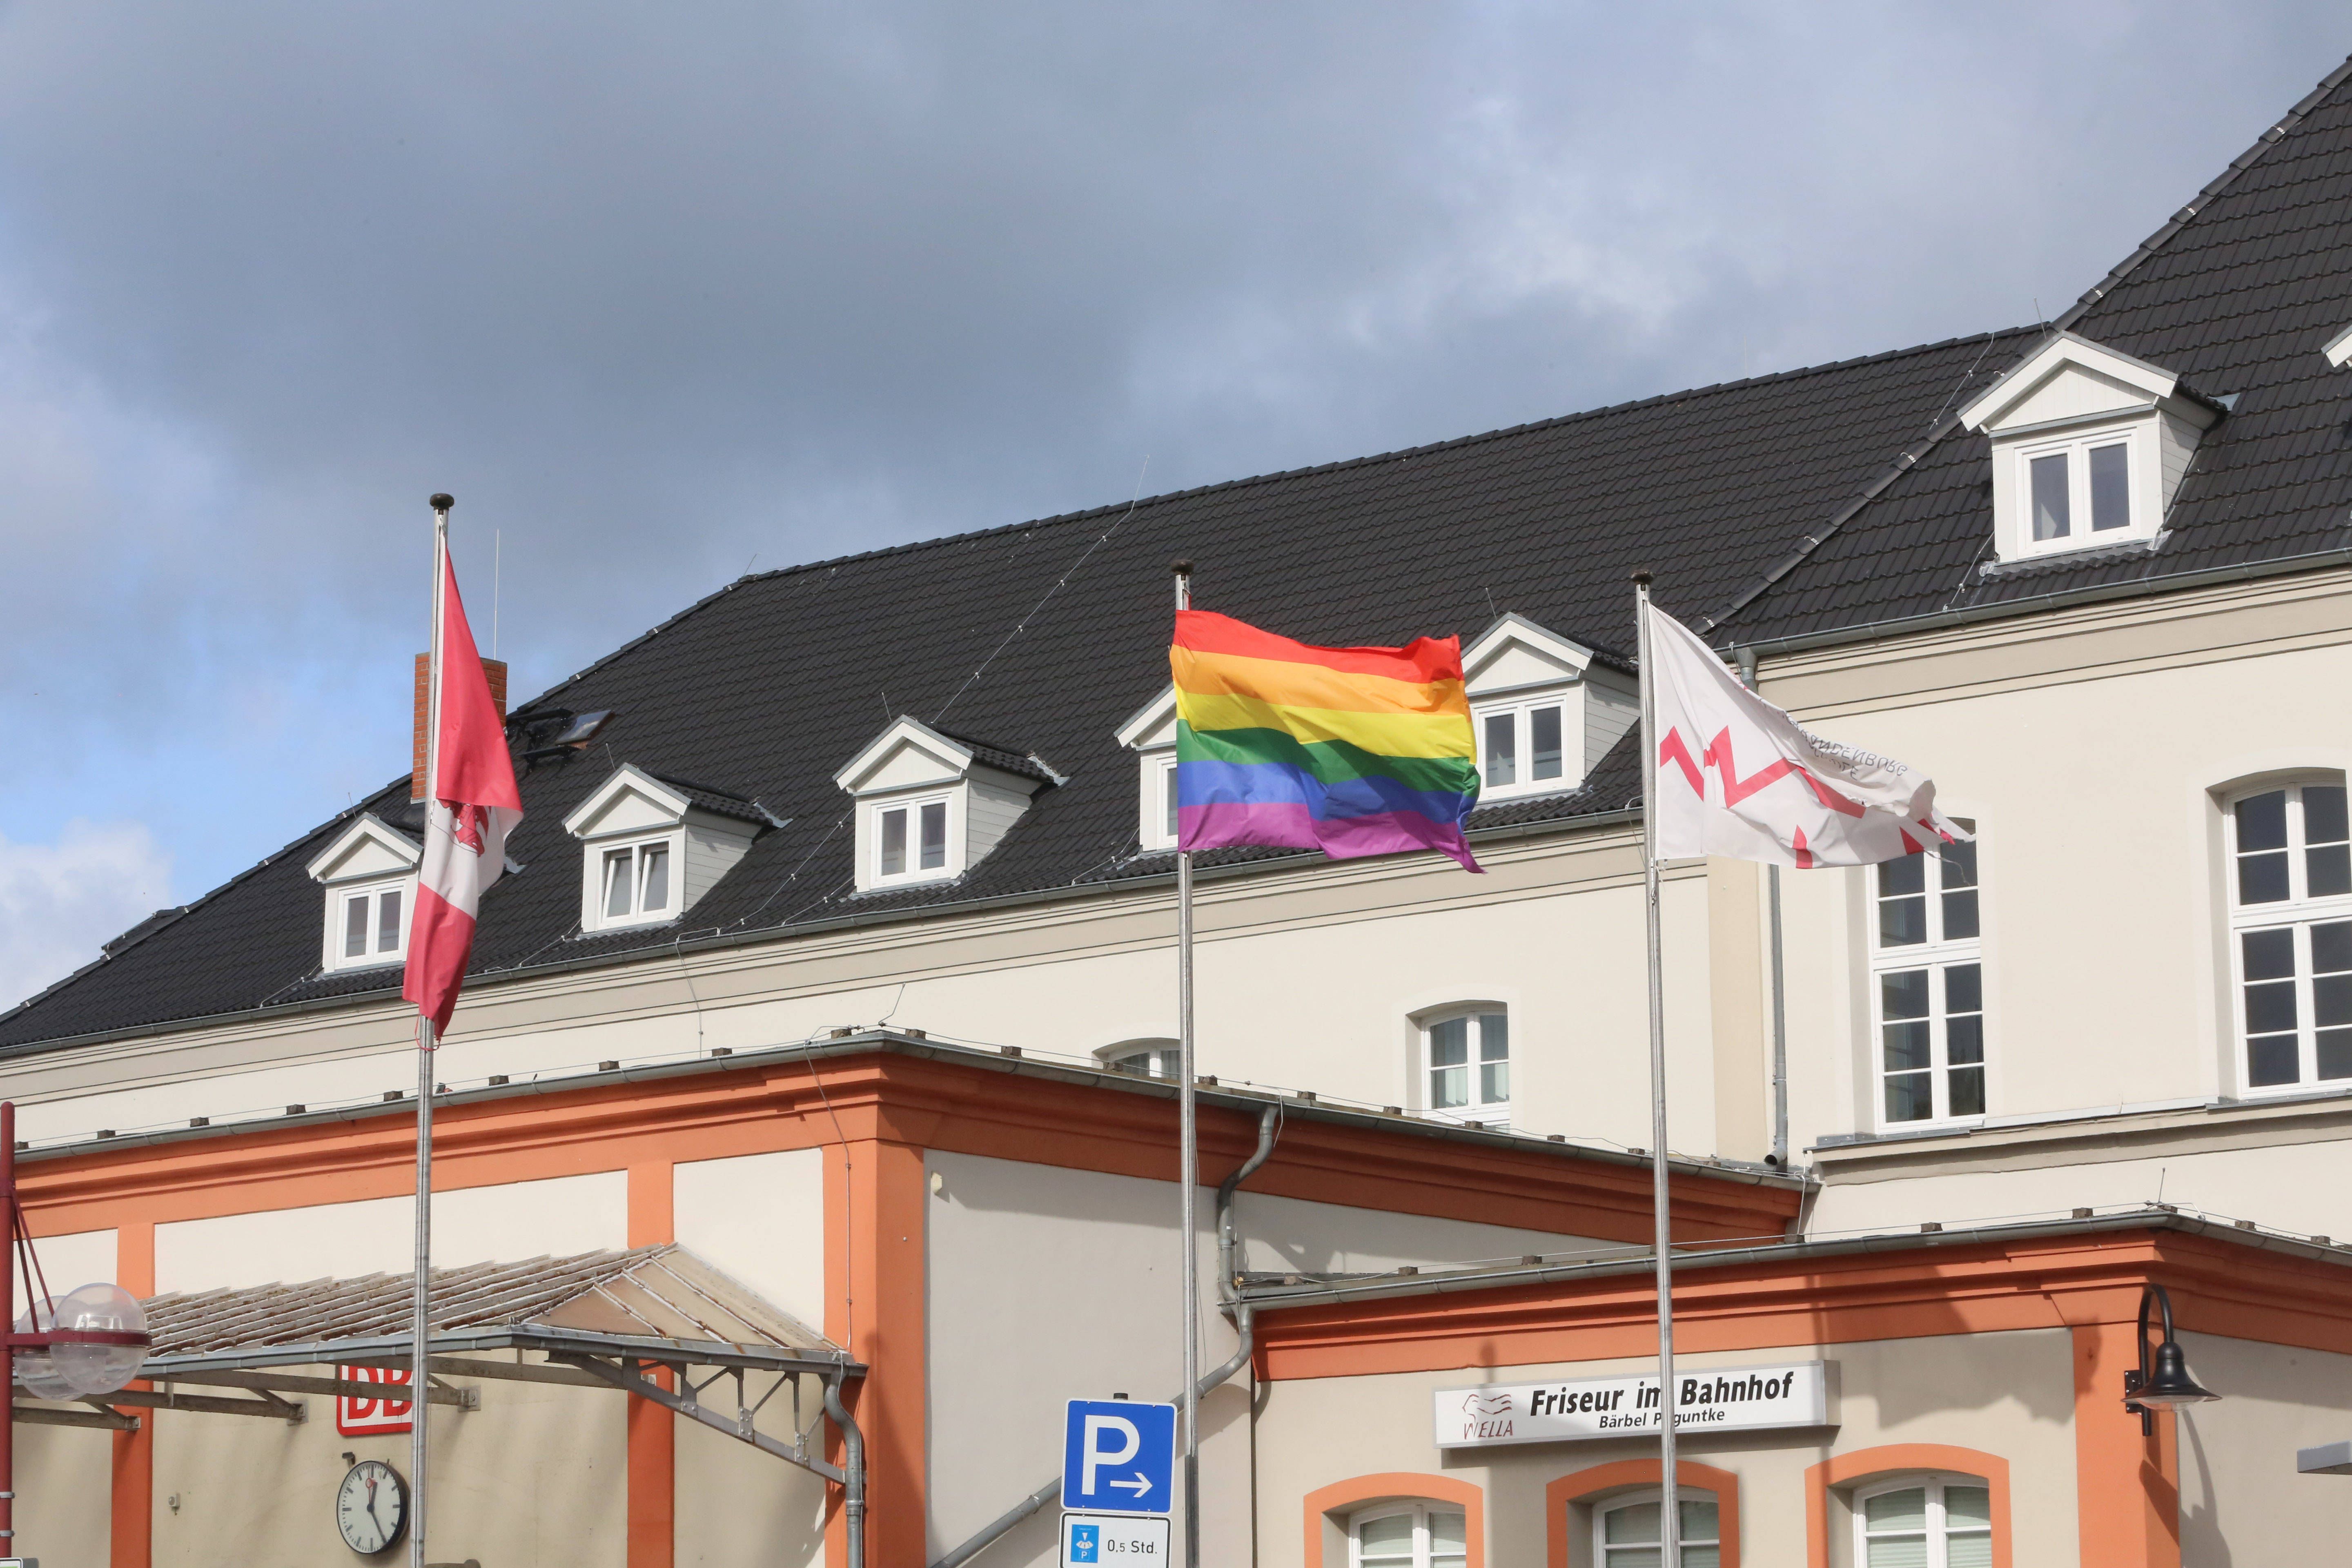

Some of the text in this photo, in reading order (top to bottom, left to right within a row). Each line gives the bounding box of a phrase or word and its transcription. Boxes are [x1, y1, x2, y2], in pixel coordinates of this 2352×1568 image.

[348, 1365, 412, 1419] DB
[1530, 1371, 1793, 1416] Friseur im Bahnhof
[1464, 1420, 1513, 1439] WELLA
[1599, 1408, 1725, 1428] Bärbel Pguntke
[1082, 1415, 1140, 1495] P
[1108, 1539, 1157, 1554] 0,5 Std.
